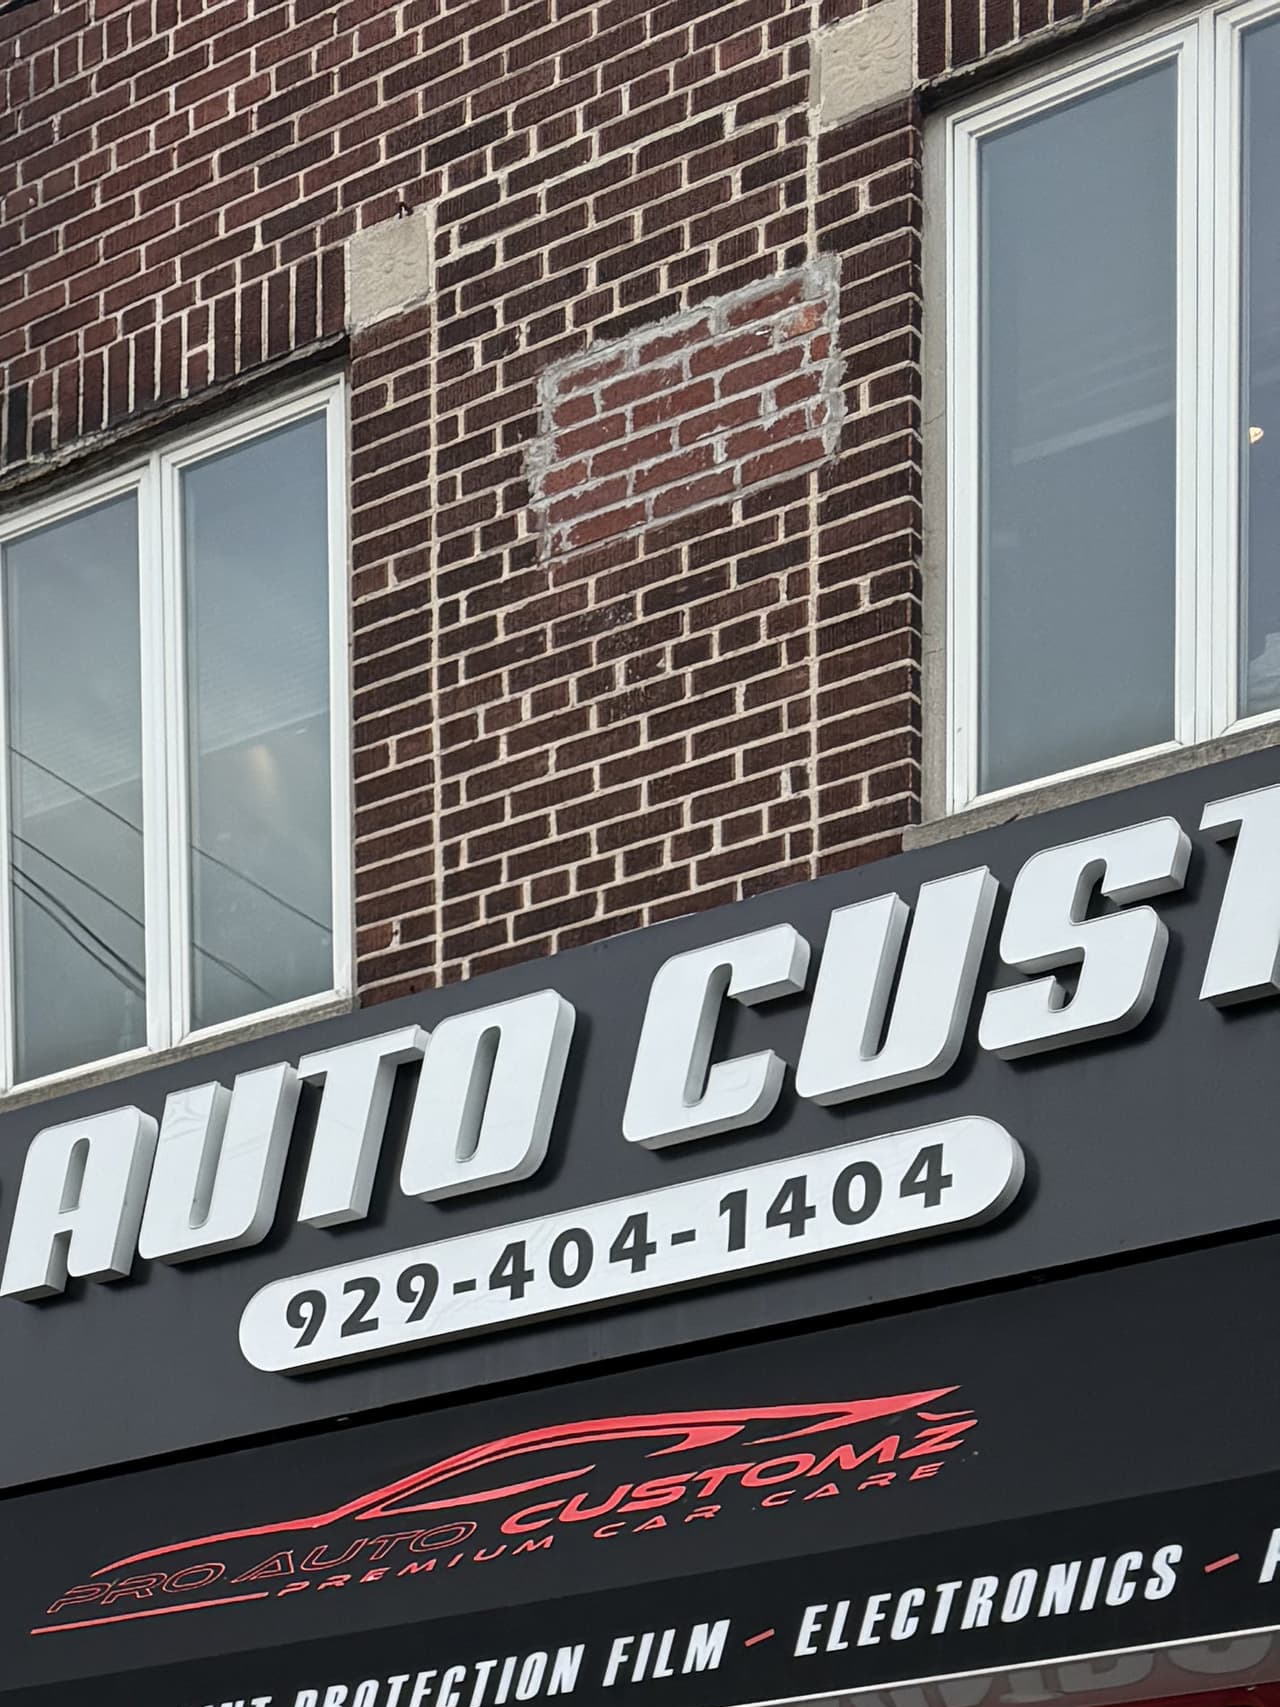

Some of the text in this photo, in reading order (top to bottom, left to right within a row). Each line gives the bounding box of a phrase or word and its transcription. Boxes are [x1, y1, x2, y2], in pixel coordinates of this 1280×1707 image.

[0, 988, 573, 1300] AUTO
[621, 784, 1280, 1151] CUST
[284, 1141, 956, 1351] 929-404-1404
[46, 1415, 978, 1614] PRO AUTO CUSTOMZ
[277, 1462, 943, 1598] PREMIUM CAR CARE
[602, 1619, 731, 1690] FILM
[794, 1544, 1182, 1657] ELECTRONICS
